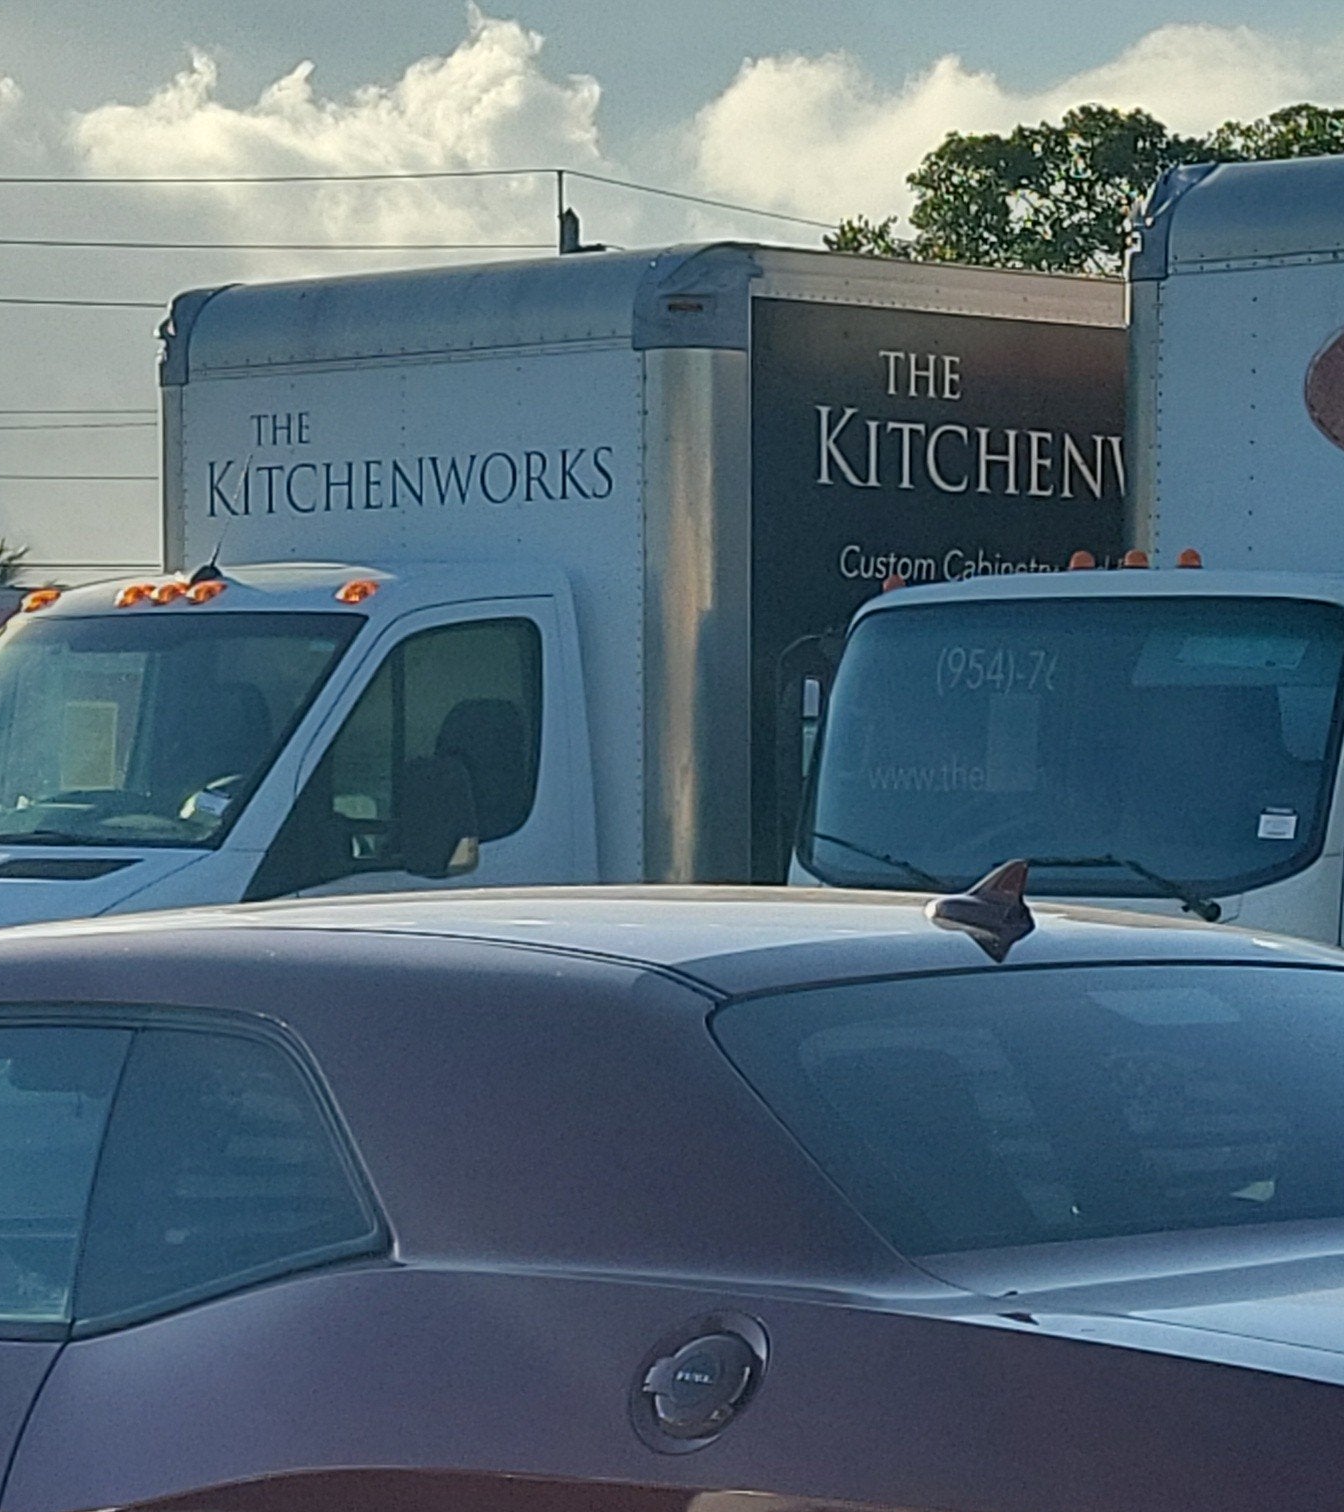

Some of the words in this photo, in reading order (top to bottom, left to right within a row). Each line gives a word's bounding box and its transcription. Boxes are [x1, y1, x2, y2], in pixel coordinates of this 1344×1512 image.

[878, 350, 961, 400] THE
[250, 412, 311, 447] THE
[814, 404, 1126, 500] KITCHEN
[207, 445, 614, 518] KITCHENWORKS
[840, 544, 935, 581] Custom
[943, 549, 1060, 581] Cabinet
